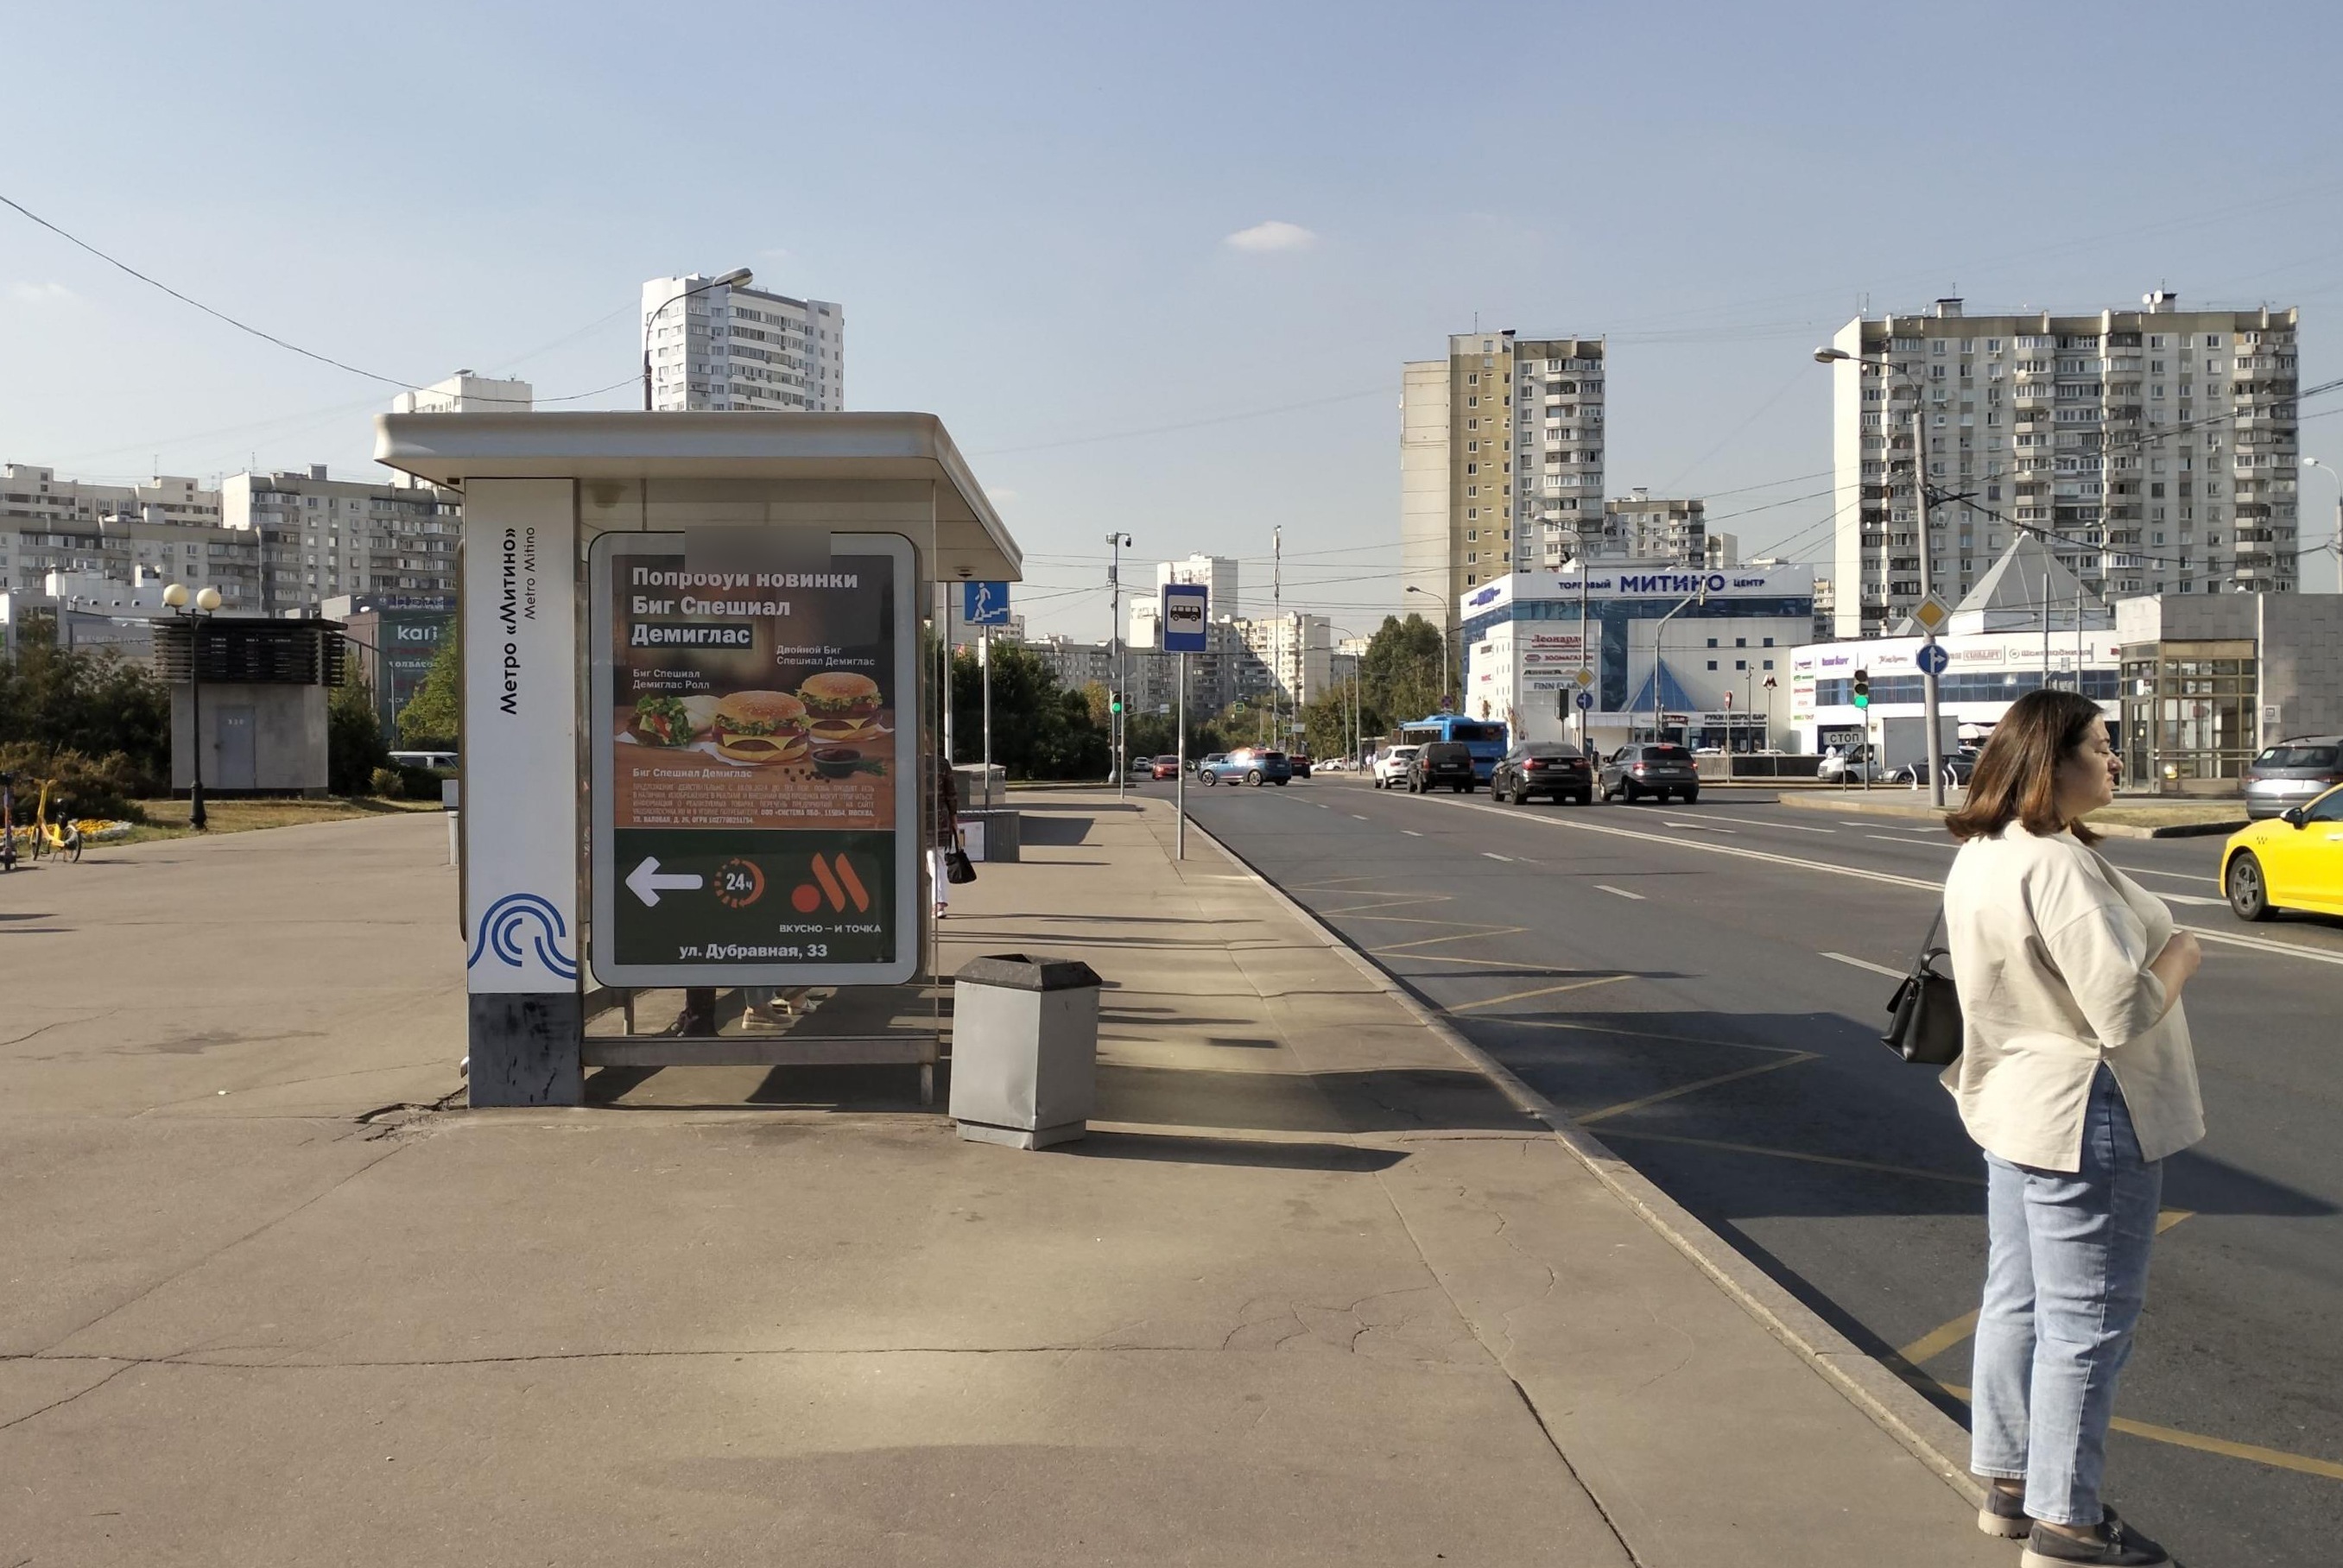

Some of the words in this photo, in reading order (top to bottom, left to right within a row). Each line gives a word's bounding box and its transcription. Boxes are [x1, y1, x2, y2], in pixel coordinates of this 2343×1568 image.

[523, 527, 535, 572] Mitino
[499, 528, 516, 635] «Митино»
[757, 572, 858, 588] новинки
[1620, 575, 1725, 592] МИТИНО
[524, 578, 535, 620] Metro
[632, 596, 674, 615] Биг
[681, 596, 790, 616] Спешиал
[397, 624, 438, 641] kari
[631, 624, 750, 645] Демиглас
[776, 645, 820, 654] Двойной
[824, 646, 841, 654] Биг
[777, 656, 823, 666] Спешиал
[826, 656, 875, 667] Демиглас
[500, 642, 520, 715] Метро
[633, 669, 650, 678] Биг
[654, 669, 700, 679] Спешиал
[633, 680, 682, 690] Демиглас
[685, 680, 710, 689] Ролл
[1830, 733, 1859, 743] СТОП
[633, 768, 650, 777] Биг
[653, 768, 699, 779] Спешиал
[702, 768, 752, 780] Демиглас
[845, 925, 882, 933] ТОЧКА
[680, 945, 702, 960] ул.
[706, 944, 802, 959] Дубравная,
[807, 944, 827, 957] 33
